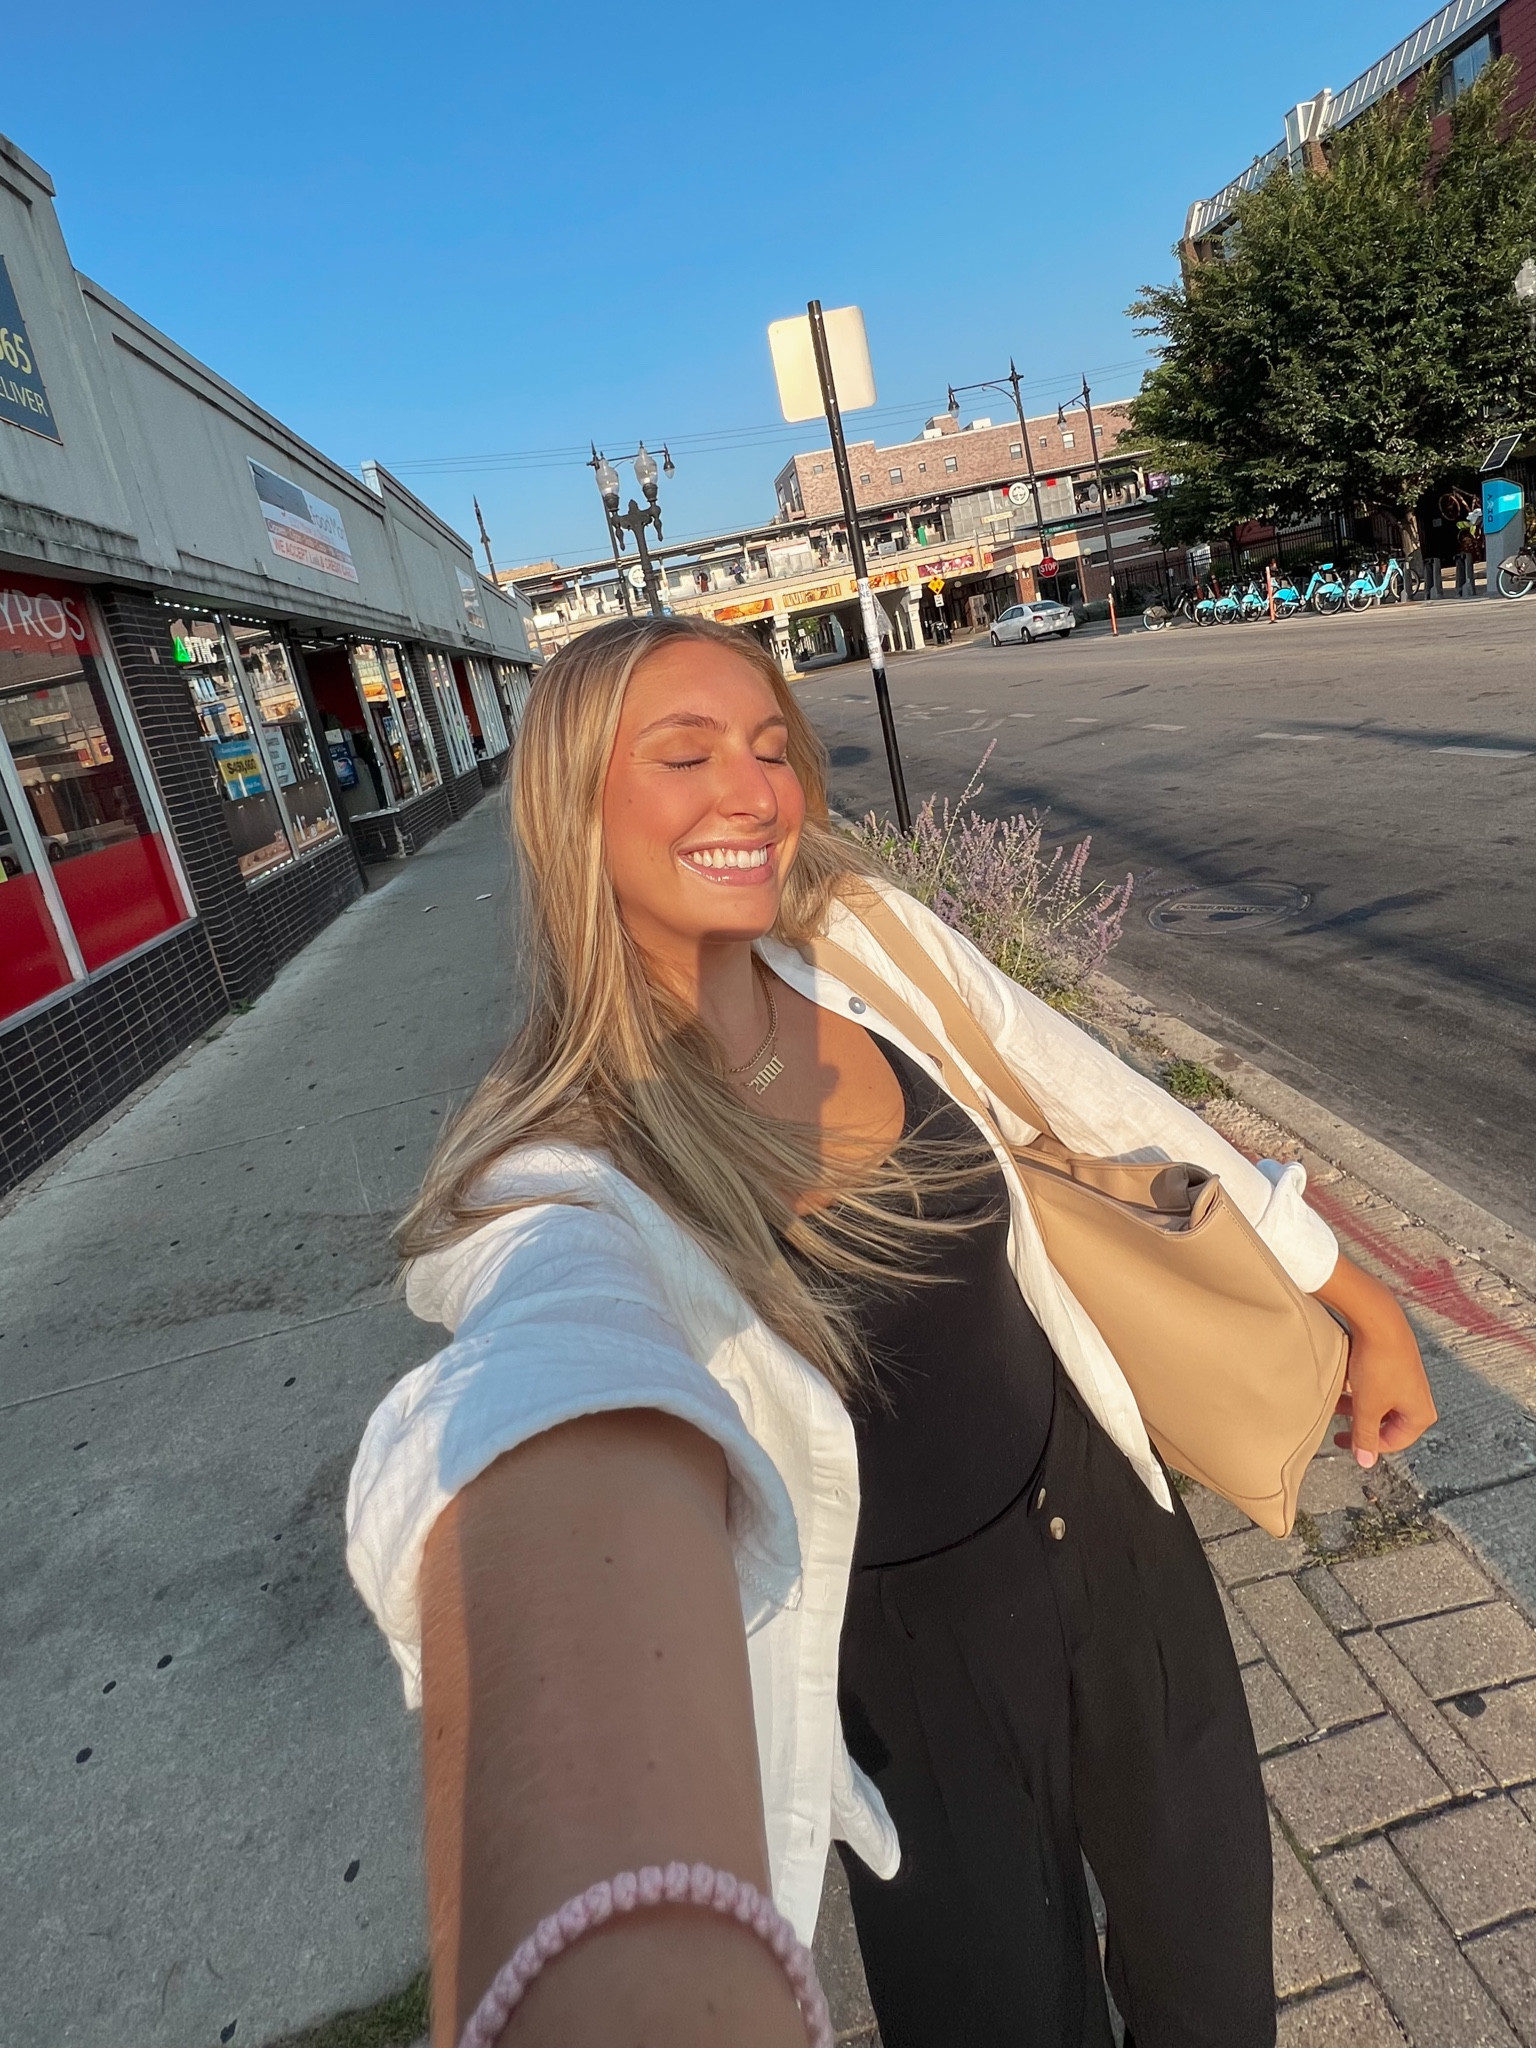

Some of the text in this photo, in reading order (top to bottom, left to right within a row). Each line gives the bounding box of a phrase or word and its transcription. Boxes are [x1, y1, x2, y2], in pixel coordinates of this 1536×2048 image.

[0, 327, 32, 375] 65
[1040, 561, 1057, 573] STOP
[0, 588, 85, 641] YROS
